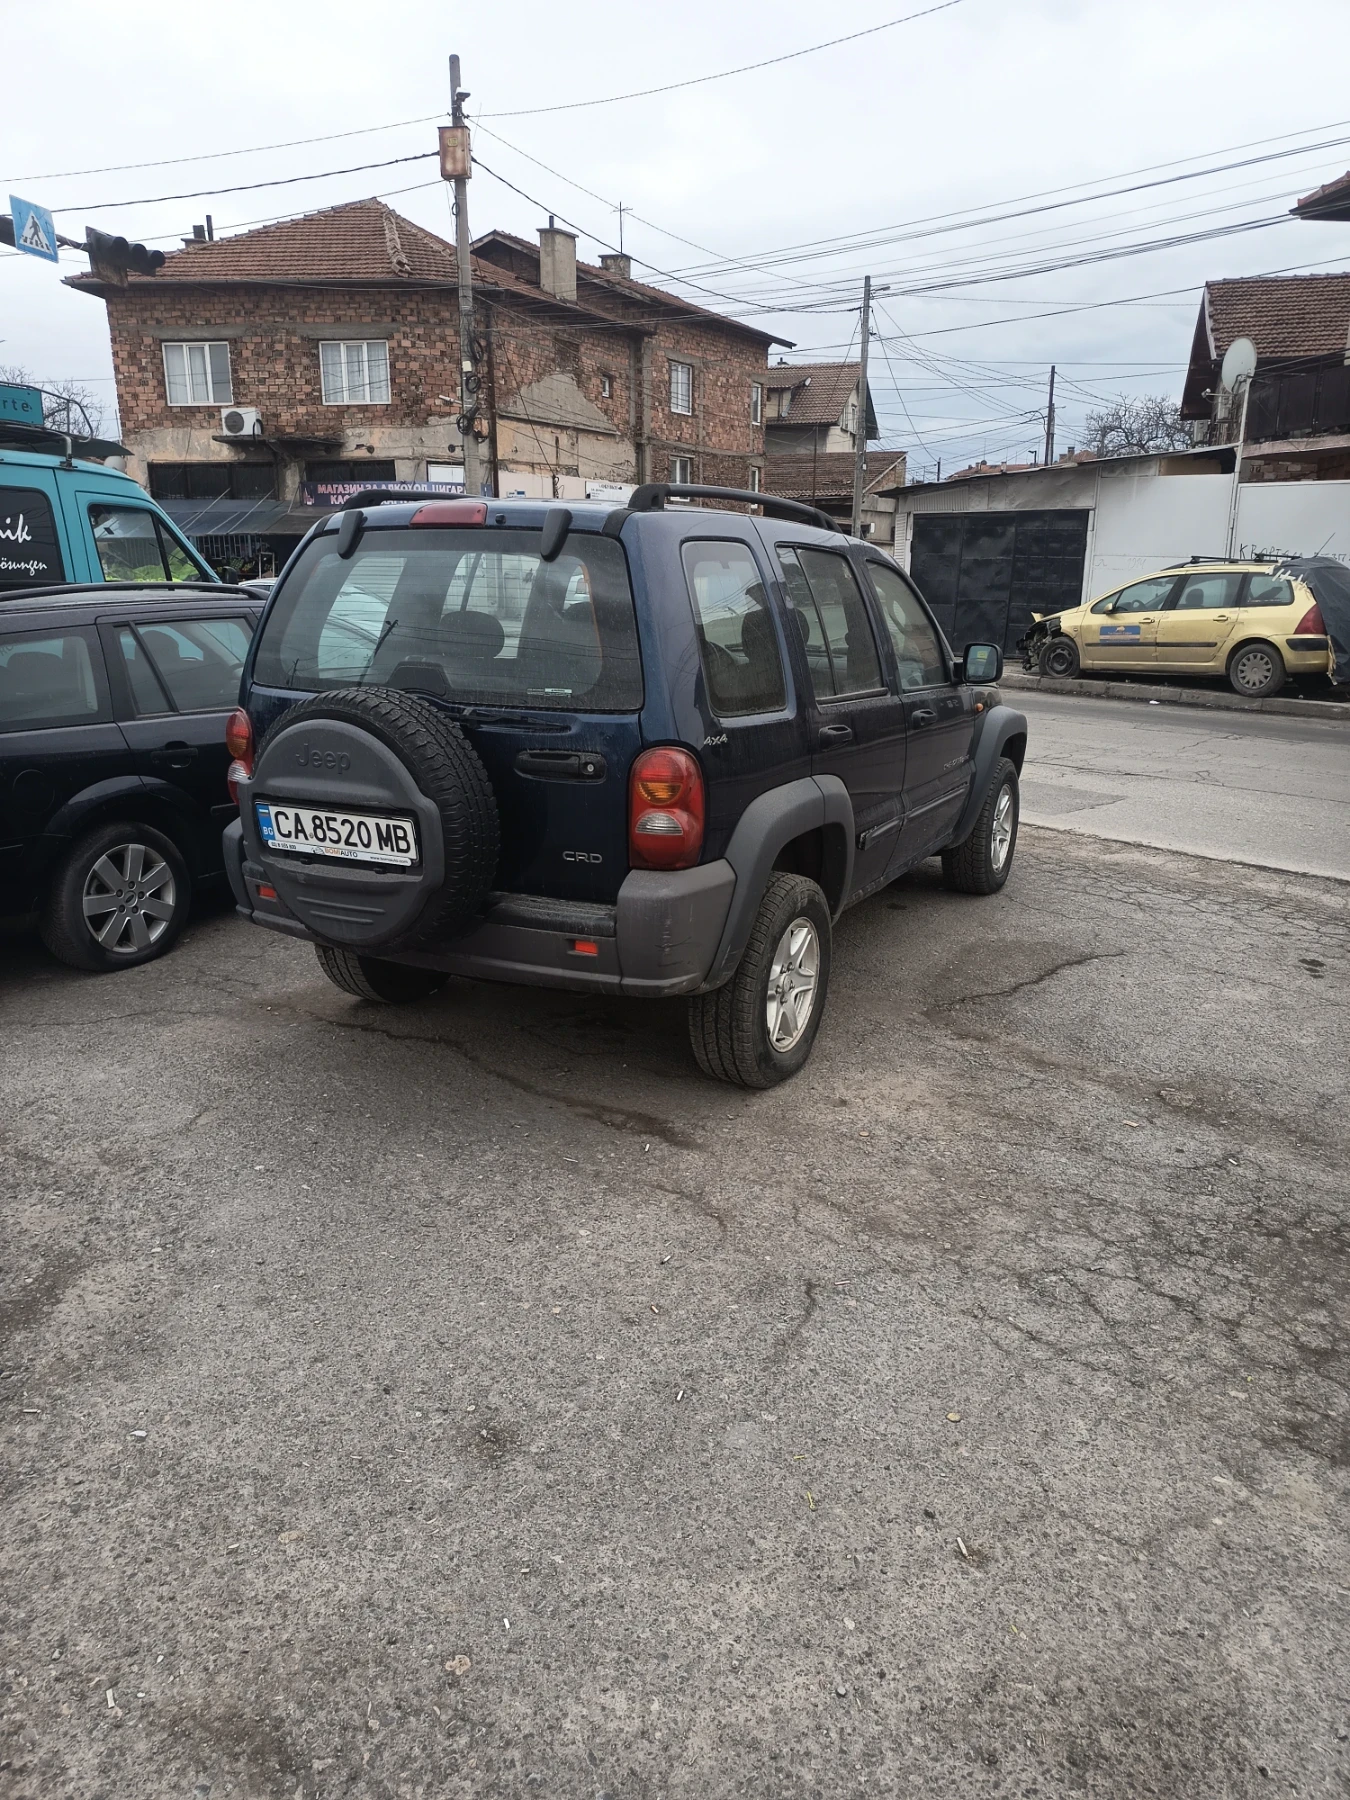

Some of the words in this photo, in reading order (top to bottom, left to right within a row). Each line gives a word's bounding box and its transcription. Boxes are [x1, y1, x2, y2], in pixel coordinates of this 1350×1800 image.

[317, 484, 364, 494] МАГАЗИН
[431, 484, 466, 495] ЦИГАР
[295, 742, 351, 775] Jeep
[262, 826, 274, 836] BG
[274, 810, 309, 841] CA
[312, 814, 372, 849] 8520
[375, 822, 411, 854] MB
[562, 850, 603, 864] CRD
